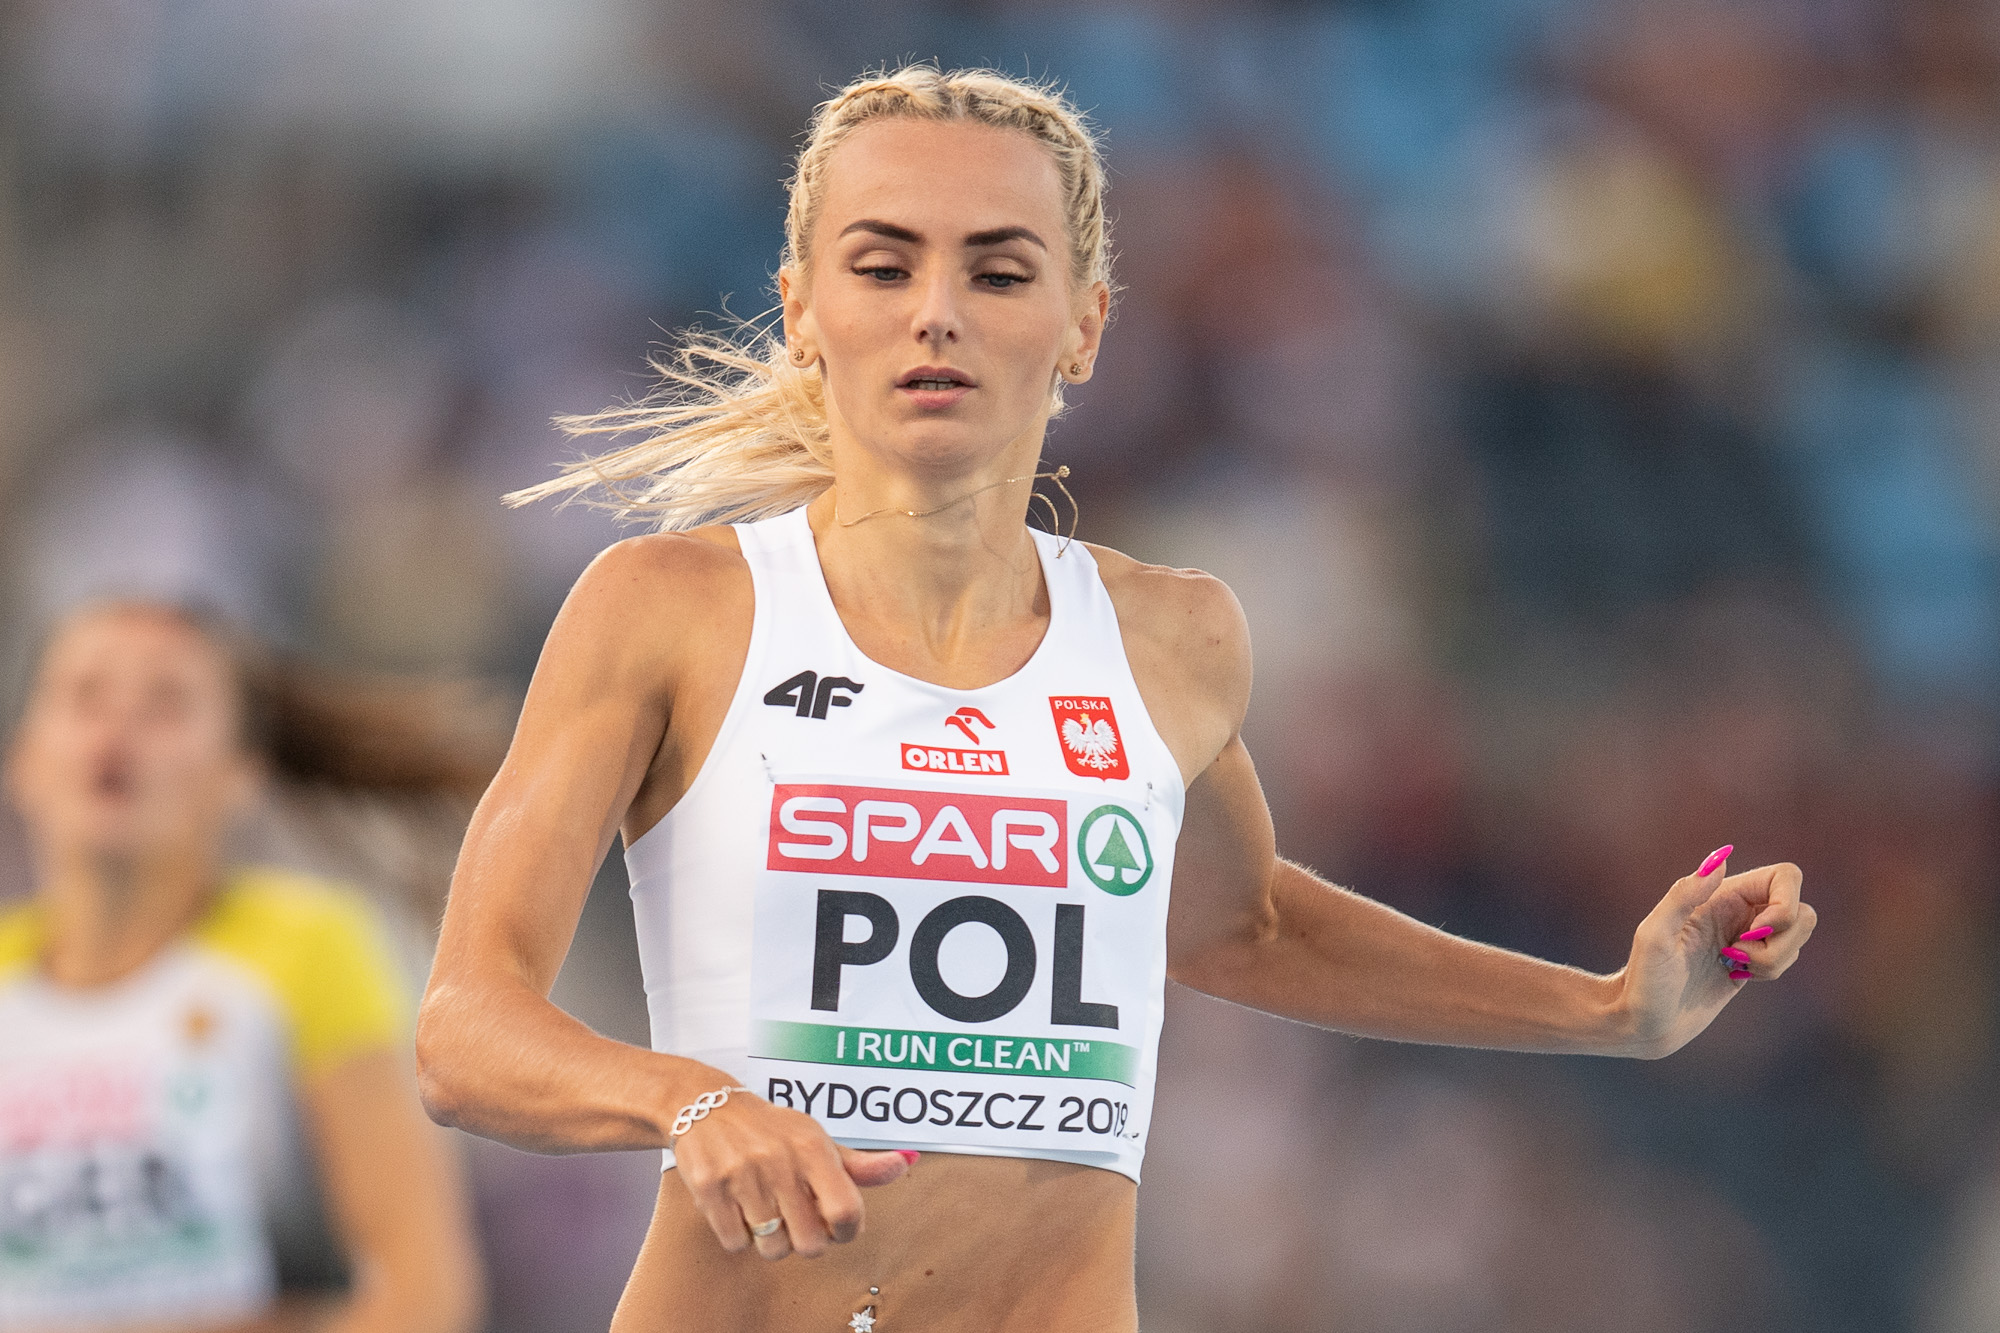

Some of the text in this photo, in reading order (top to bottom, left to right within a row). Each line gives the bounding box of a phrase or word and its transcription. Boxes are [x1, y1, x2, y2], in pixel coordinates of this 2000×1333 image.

[763, 670, 865, 720] 4F
[1054, 700, 1109, 710] POLSKA
[905, 747, 1003, 773] ORLEN
[778, 796, 1060, 874] SPAR
[810, 889, 1119, 1030] POL
[836, 1031, 845, 1058] I
[857, 1031, 936, 1064] RUN
[768, 1077, 1129, 1138] BYDGOSZCZ 2019
